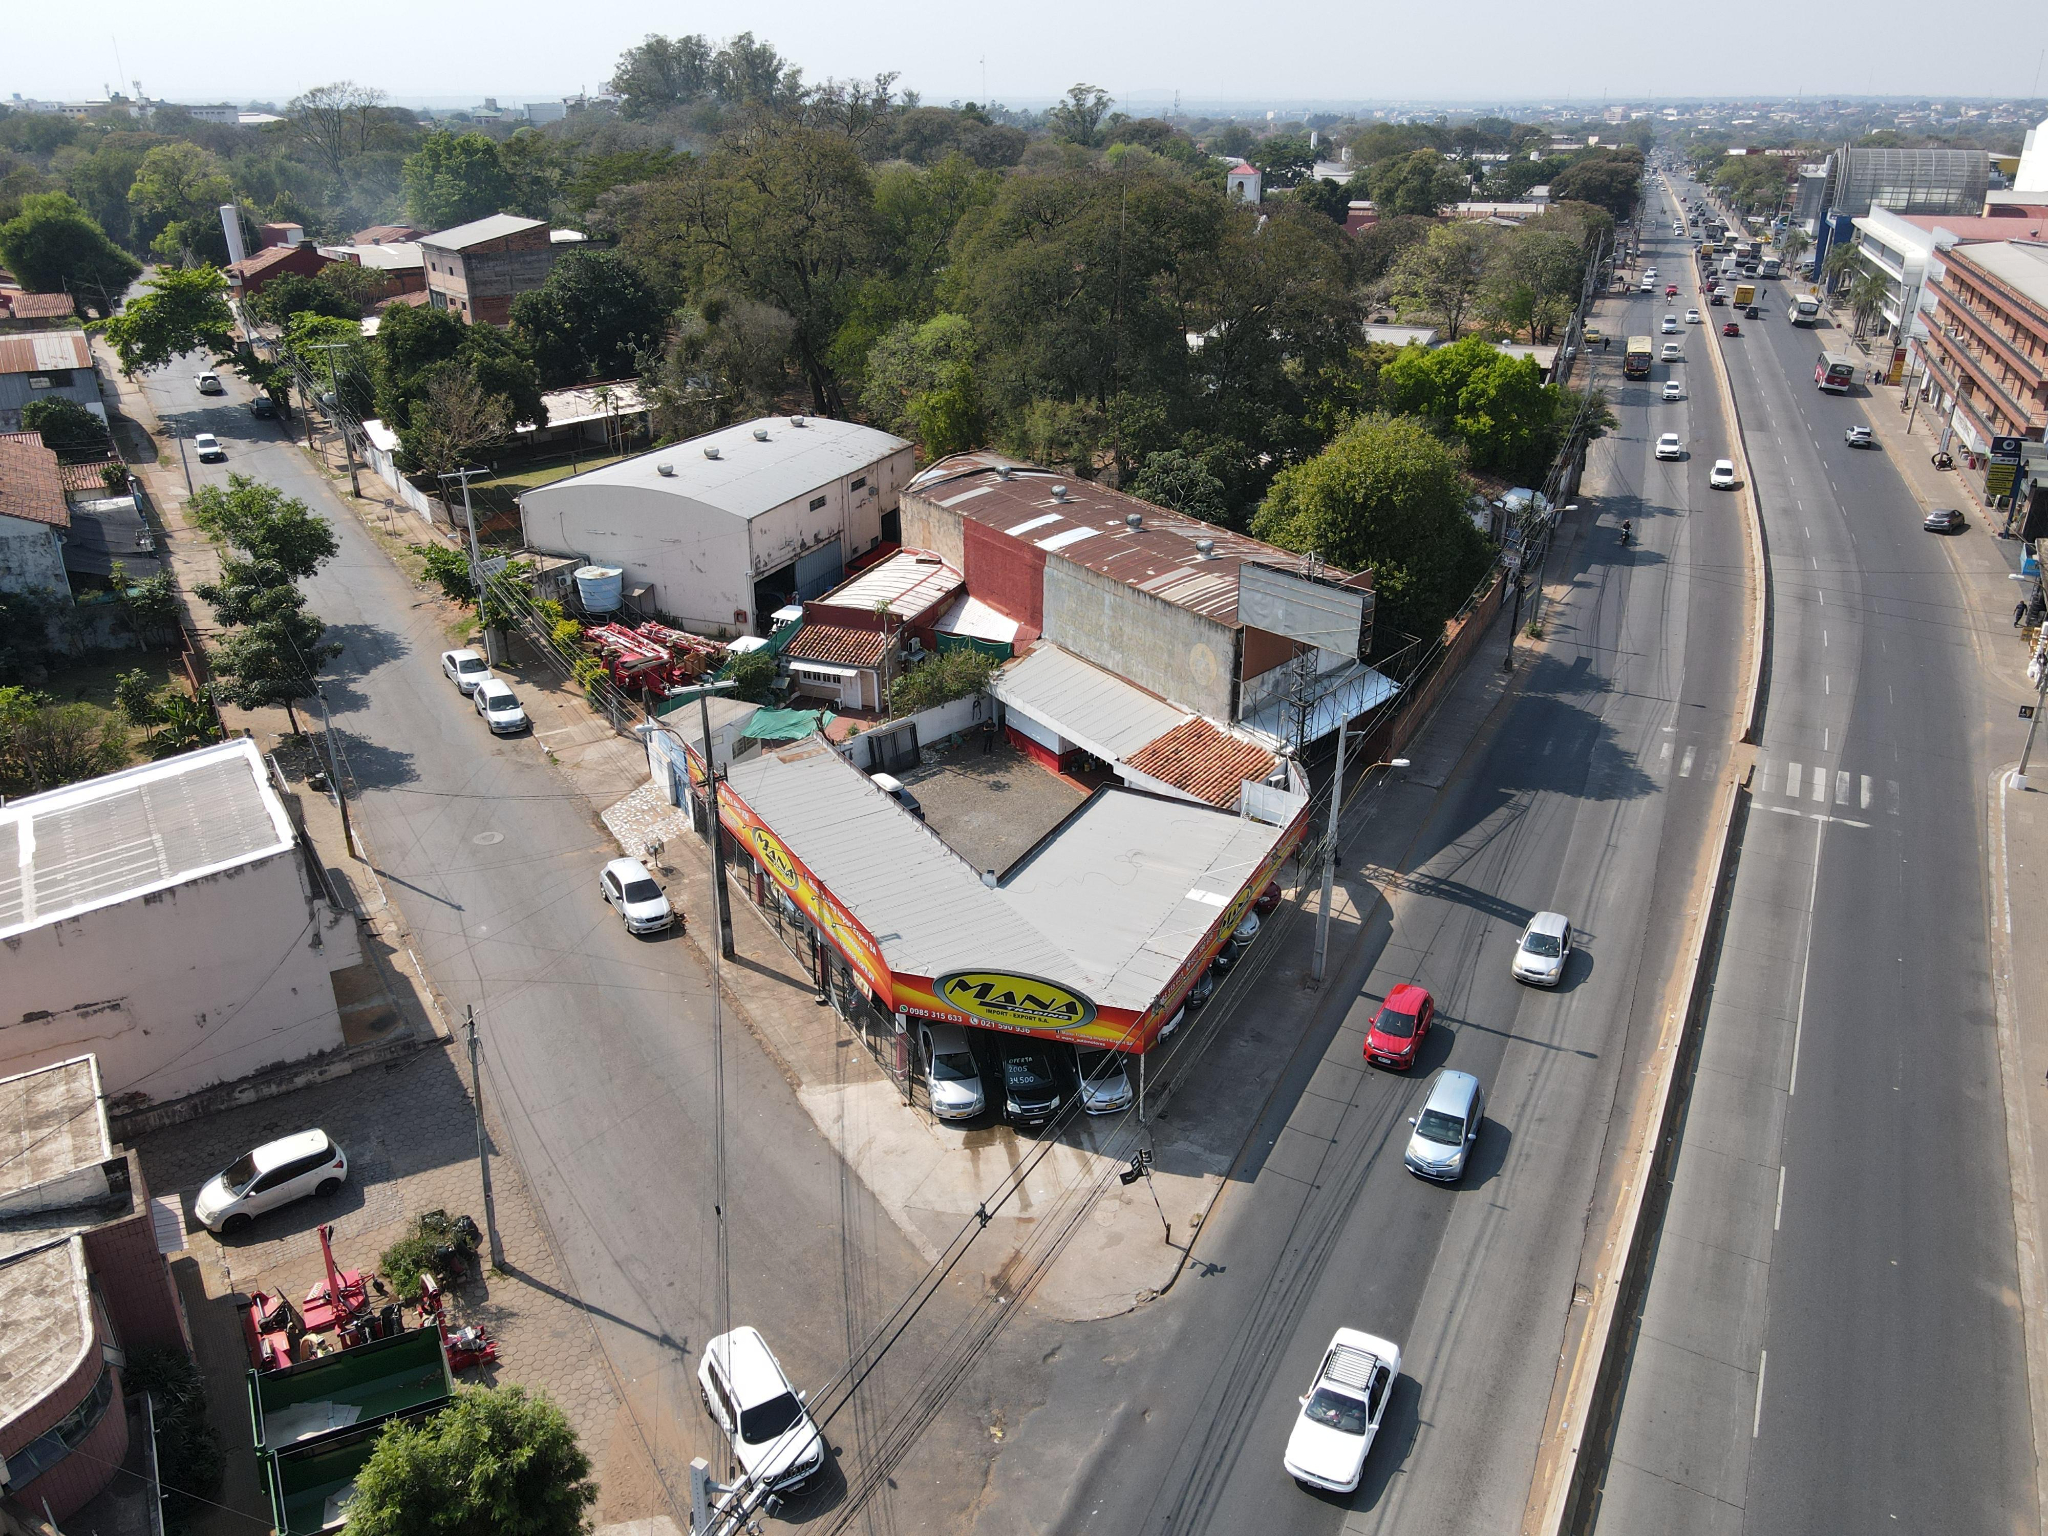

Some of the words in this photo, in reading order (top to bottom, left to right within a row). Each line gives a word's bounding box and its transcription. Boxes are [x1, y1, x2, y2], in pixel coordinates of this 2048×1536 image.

[948, 978, 1079, 1016] MANA
[909, 1007, 929, 1016] 0985
[931, 1011, 946, 1020] 315
[947, 1013, 963, 1022] 633
[985, 1008, 1008, 1017] IMPORT
[1013, 1013, 1036, 1022] EXPORT
[1006, 1006, 1069, 1020] TRADING
[980, 1020, 995, 1028] 021
[1008, 1065, 1028, 1073] 2005
